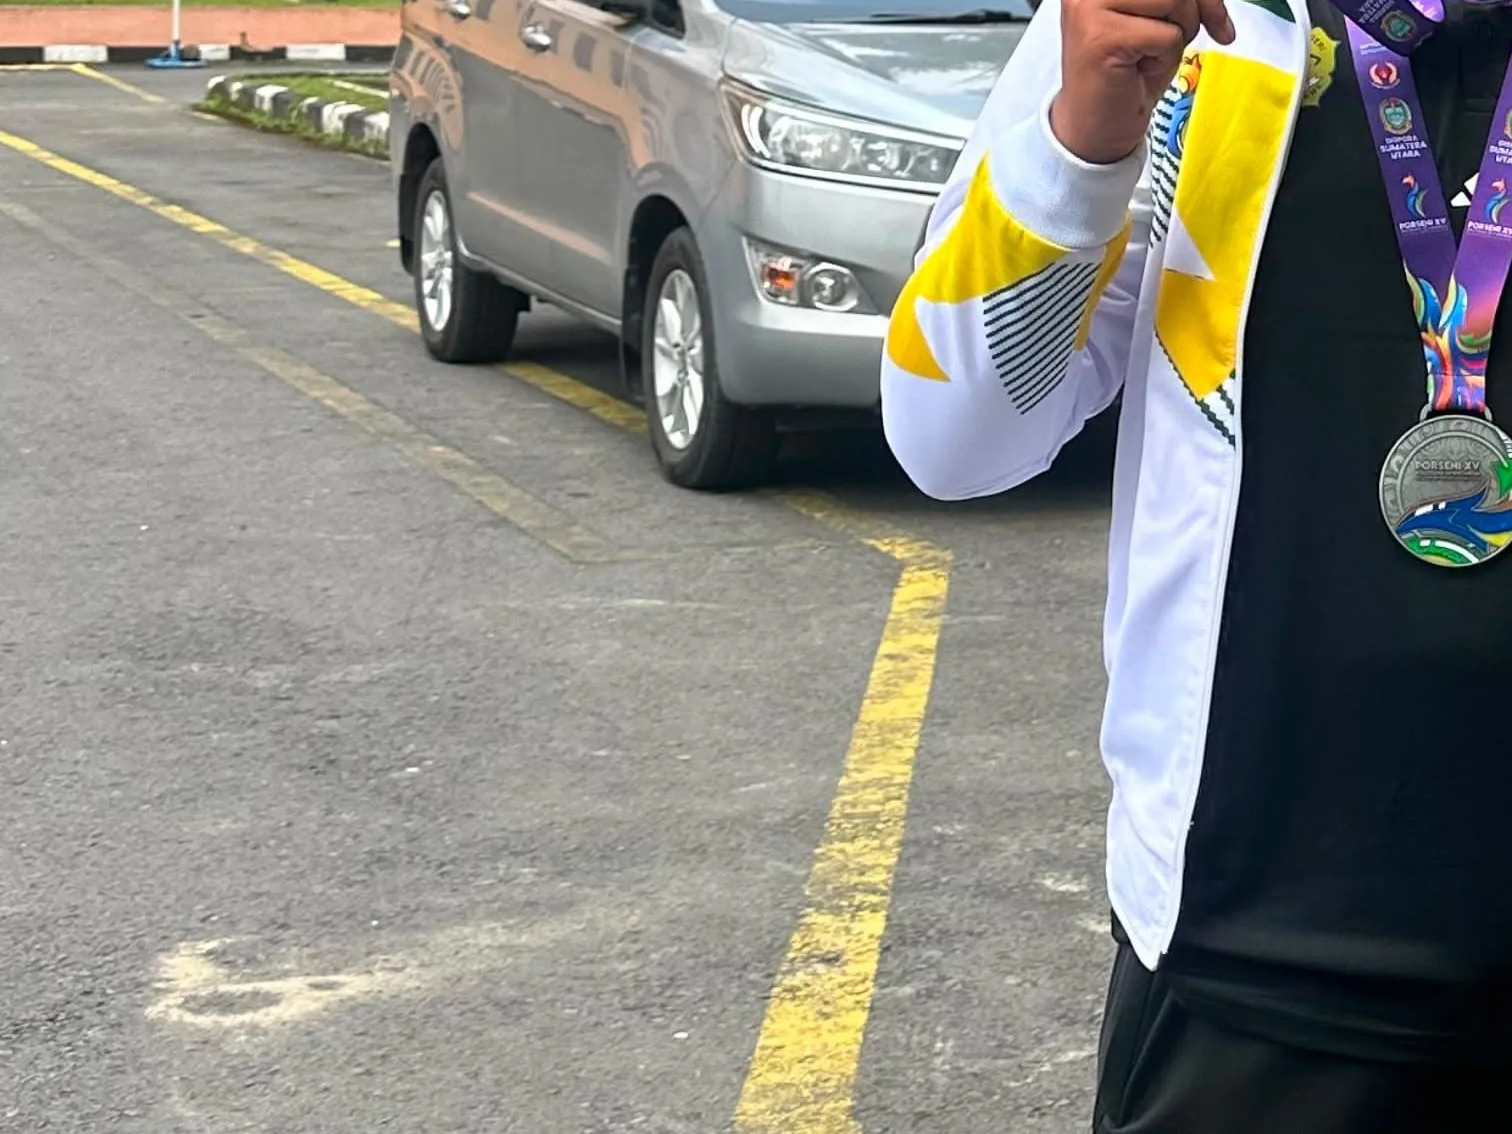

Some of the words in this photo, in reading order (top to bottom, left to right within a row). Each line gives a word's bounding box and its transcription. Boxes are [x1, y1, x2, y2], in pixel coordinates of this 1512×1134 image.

[1380, 140, 1428, 153] SUMATERA
[1391, 149, 1421, 160] UTARA
[1399, 219, 1433, 230] PORSENI
[1434, 217, 1447, 226] XV
[1467, 221, 1501, 233] PORSENI
[1415, 459, 1462, 471] PORSENI
[1464, 460, 1481, 471] XV
